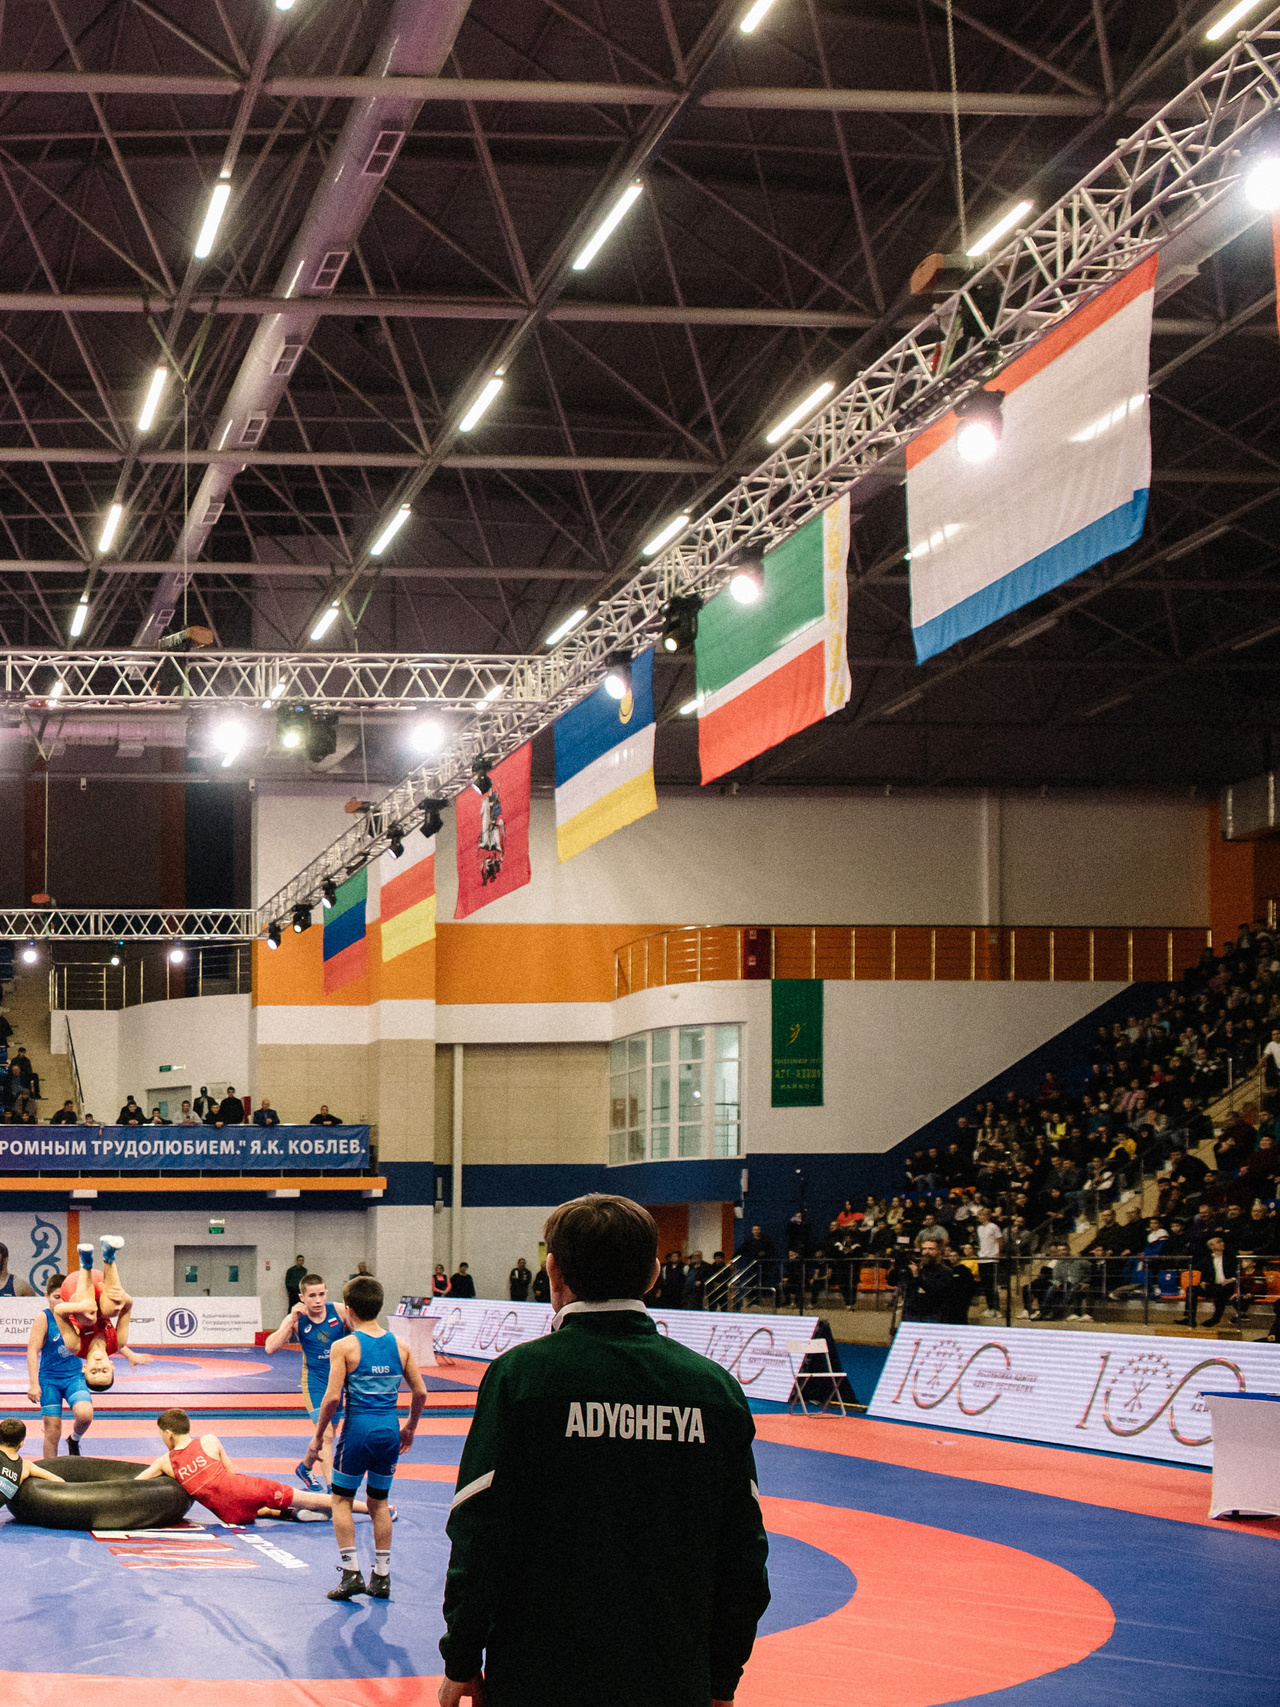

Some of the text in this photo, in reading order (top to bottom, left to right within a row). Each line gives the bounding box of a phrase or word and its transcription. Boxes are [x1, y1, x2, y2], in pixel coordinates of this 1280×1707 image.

[91, 1139, 247, 1158] ТРУДОЛЮБИЕМ."
[250, 1139, 284, 1155] Я.К.
[289, 1138, 367, 1155] КОБЛЕВ.
[371, 1365, 390, 1374] RUS
[565, 1401, 706, 1444] ADYGHEYA
[1, 1466, 18, 1482] RUS
[177, 1455, 207, 1480] RUS
